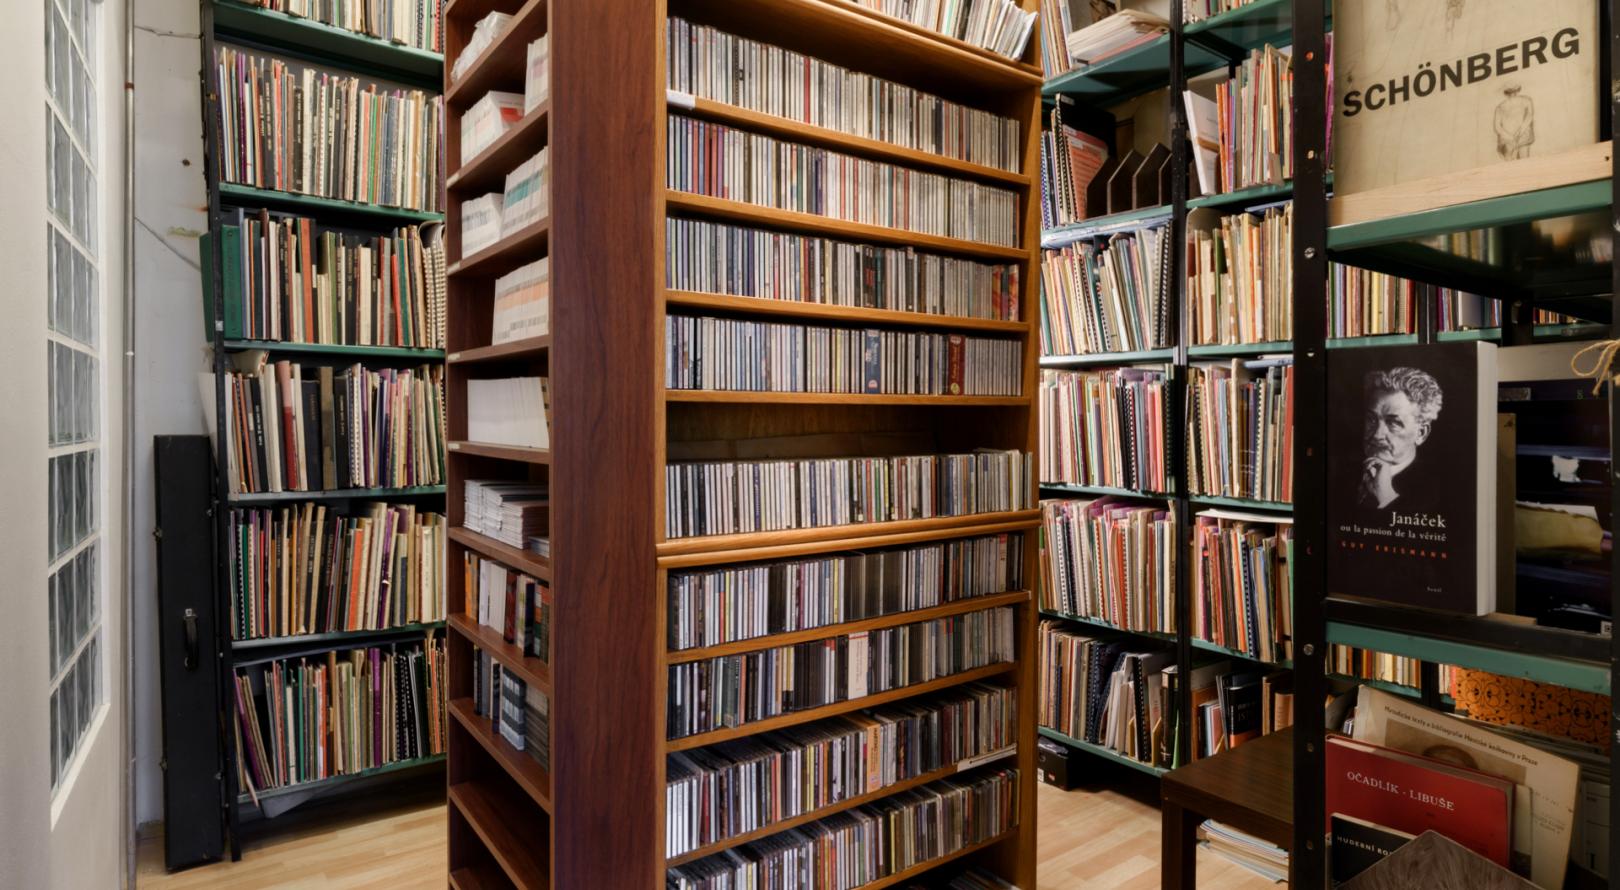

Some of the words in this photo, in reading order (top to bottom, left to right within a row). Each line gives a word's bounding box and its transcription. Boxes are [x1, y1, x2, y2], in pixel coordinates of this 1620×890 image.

[1342, 27, 1580, 117] SCHÖNBERG
[1389, 511, 1446, 528] Janáček
[1353, 524, 1361, 532] la
[1363, 526, 1392, 536] passion
[1395, 529, 1406, 538] de
[1408, 530, 1416, 538] la
[1419, 531, 1447, 541] vérité
[1346, 771, 1400, 794] OČADLÍK
[1409, 790, 1455, 811] LIBUŠE
[1336, 835, 1375, 852] HUDEBNÍ
